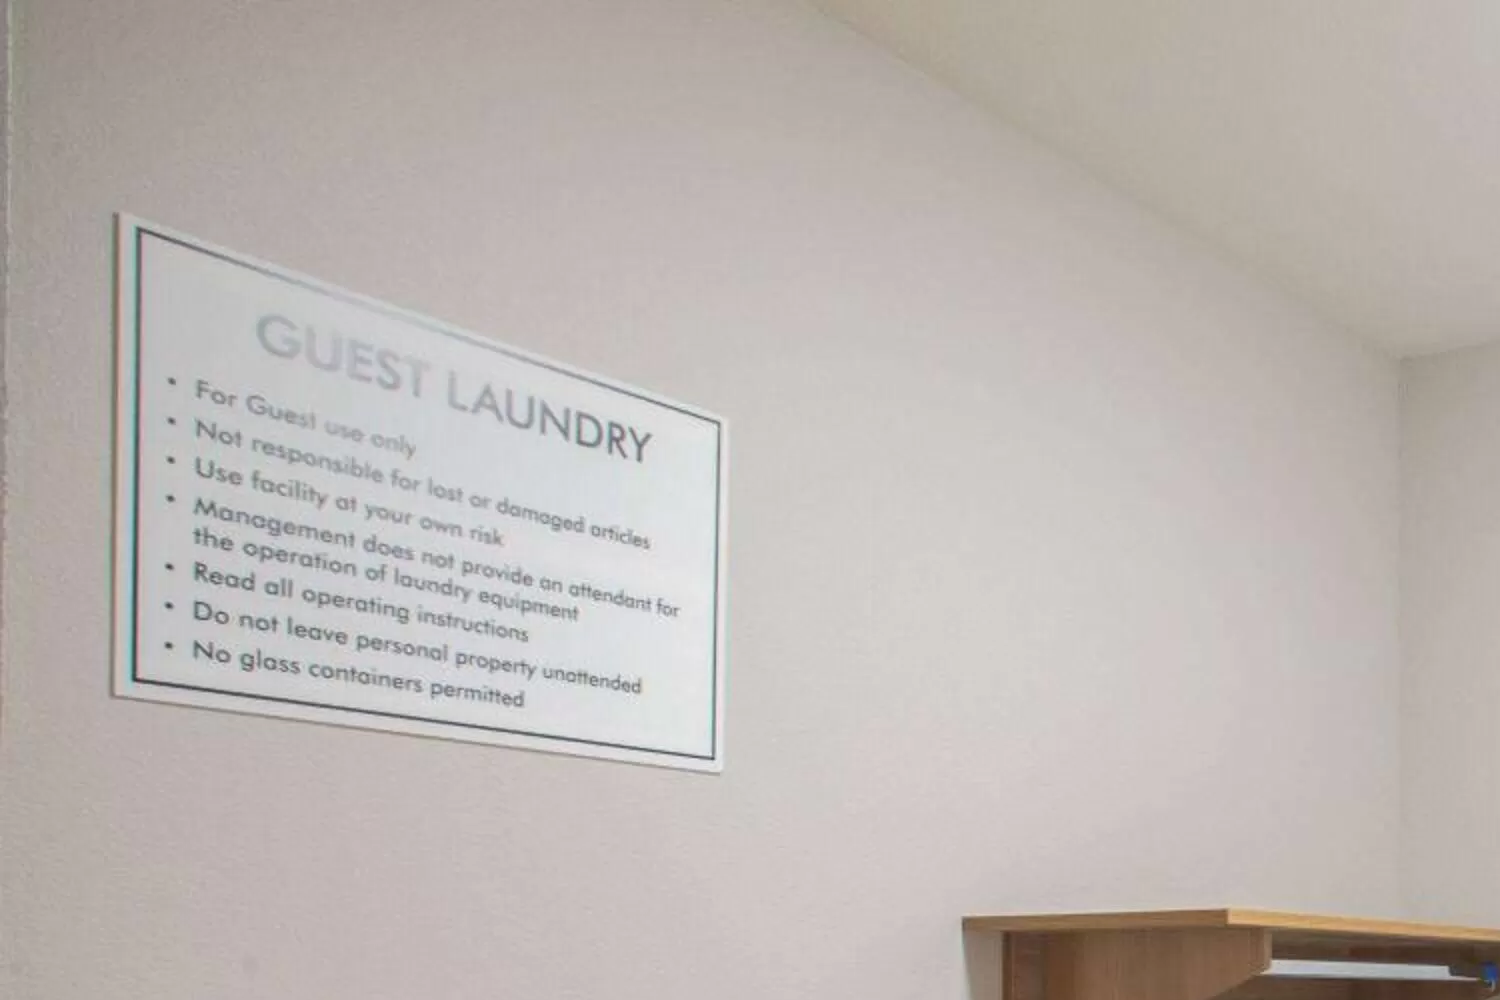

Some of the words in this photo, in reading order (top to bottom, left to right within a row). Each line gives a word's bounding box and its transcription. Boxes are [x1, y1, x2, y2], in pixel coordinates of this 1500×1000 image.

[195, 379, 237, 407] For
[246, 394, 317, 430] Guest
[324, 420, 365, 442] use
[370, 432, 416, 460] only
[255, 313, 432, 398] GUEST
[446, 369, 653, 464] LAUNDRY
[194, 417, 242, 448] Not
[252, 437, 385, 483] responsible
[390, 468, 422, 491] for
[428, 477, 463, 503] lost
[469, 492, 490, 508] or
[496, 496, 586, 534] damaged
[591, 523, 651, 549] articles
[194, 456, 243, 486] Use
[252, 469, 329, 509] facility
[335, 496, 357, 512] at
[365, 502, 412, 525] your
[419, 514, 463, 537] own
[470, 525, 504, 547] risk
[193, 497, 355, 547] Management
[363, 535, 415, 560] does
[422, 550, 454, 569] not
[462, 558, 533, 586] provide
[539, 576, 563, 593] an
[568, 581, 651, 610] attendant
[656, 599, 681, 617] for
[193, 527, 234, 552] the
[242, 541, 357, 576] operation
[365, 566, 387, 581] of
[394, 568, 471, 603] laundry
[478, 588, 579, 621] equipment
[193, 561, 256, 591] Read
[264, 578, 293, 598] all
[301, 587, 410, 624] operating
[417, 604, 528, 642] instructions
[193, 601, 229, 625] Do
[239, 614, 279, 632] not
[287, 617, 348, 645] leave
[356, 635, 448, 662] personal
[455, 651, 537, 681] property
[543, 667, 643, 694] unattended
[193, 640, 232, 665] No
[240, 649, 301, 674] glass
[308, 662, 423, 693] containers
[431, 683, 525, 707] permitted
